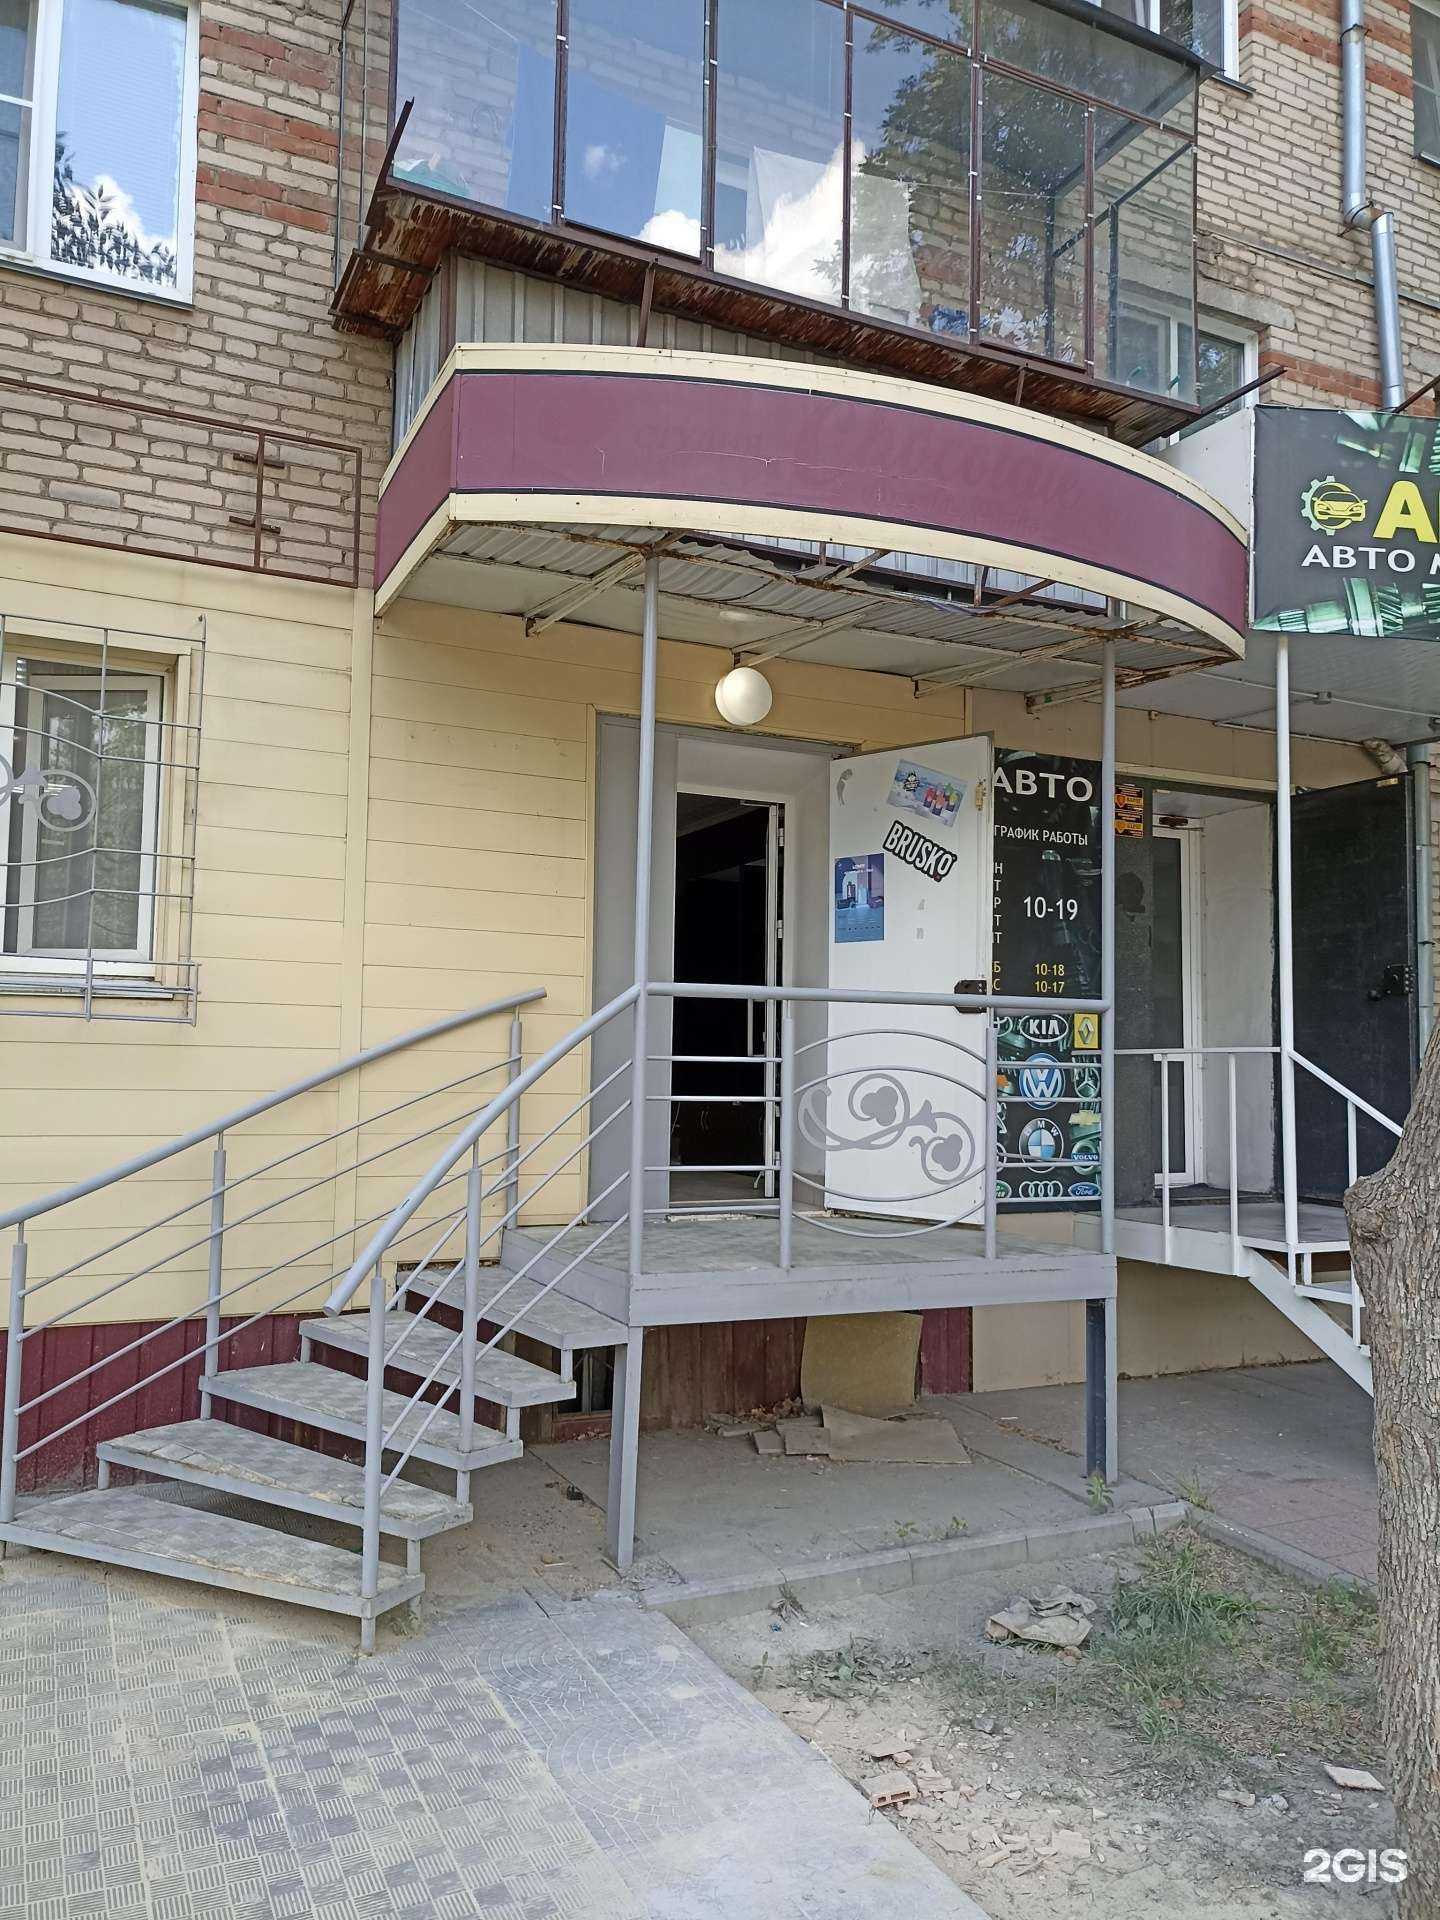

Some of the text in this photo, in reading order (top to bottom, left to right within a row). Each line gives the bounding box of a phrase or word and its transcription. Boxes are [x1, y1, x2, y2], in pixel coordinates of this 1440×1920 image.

[1373, 480, 1440, 543] А
[1301, 544, 1416, 573] АВТО
[993, 766, 1093, 802] АВТО
[994, 824, 1088, 846] ГРАФИК РАБОТЫ
[884, 822, 954, 877] BRUSKO
[994, 862, 1003, 875] Н
[1023, 896, 1078, 921] 10-19
[1034, 963, 1065, 977] 10-18
[1034, 980, 1065, 994] 10-17
[1029, 1018, 1060, 1035] KIA
[1023, 1119, 1060, 1137] BMW
[1072, 1153, 1099, 1161] VOLVO
[1075, 1185, 1095, 1196] Ford
